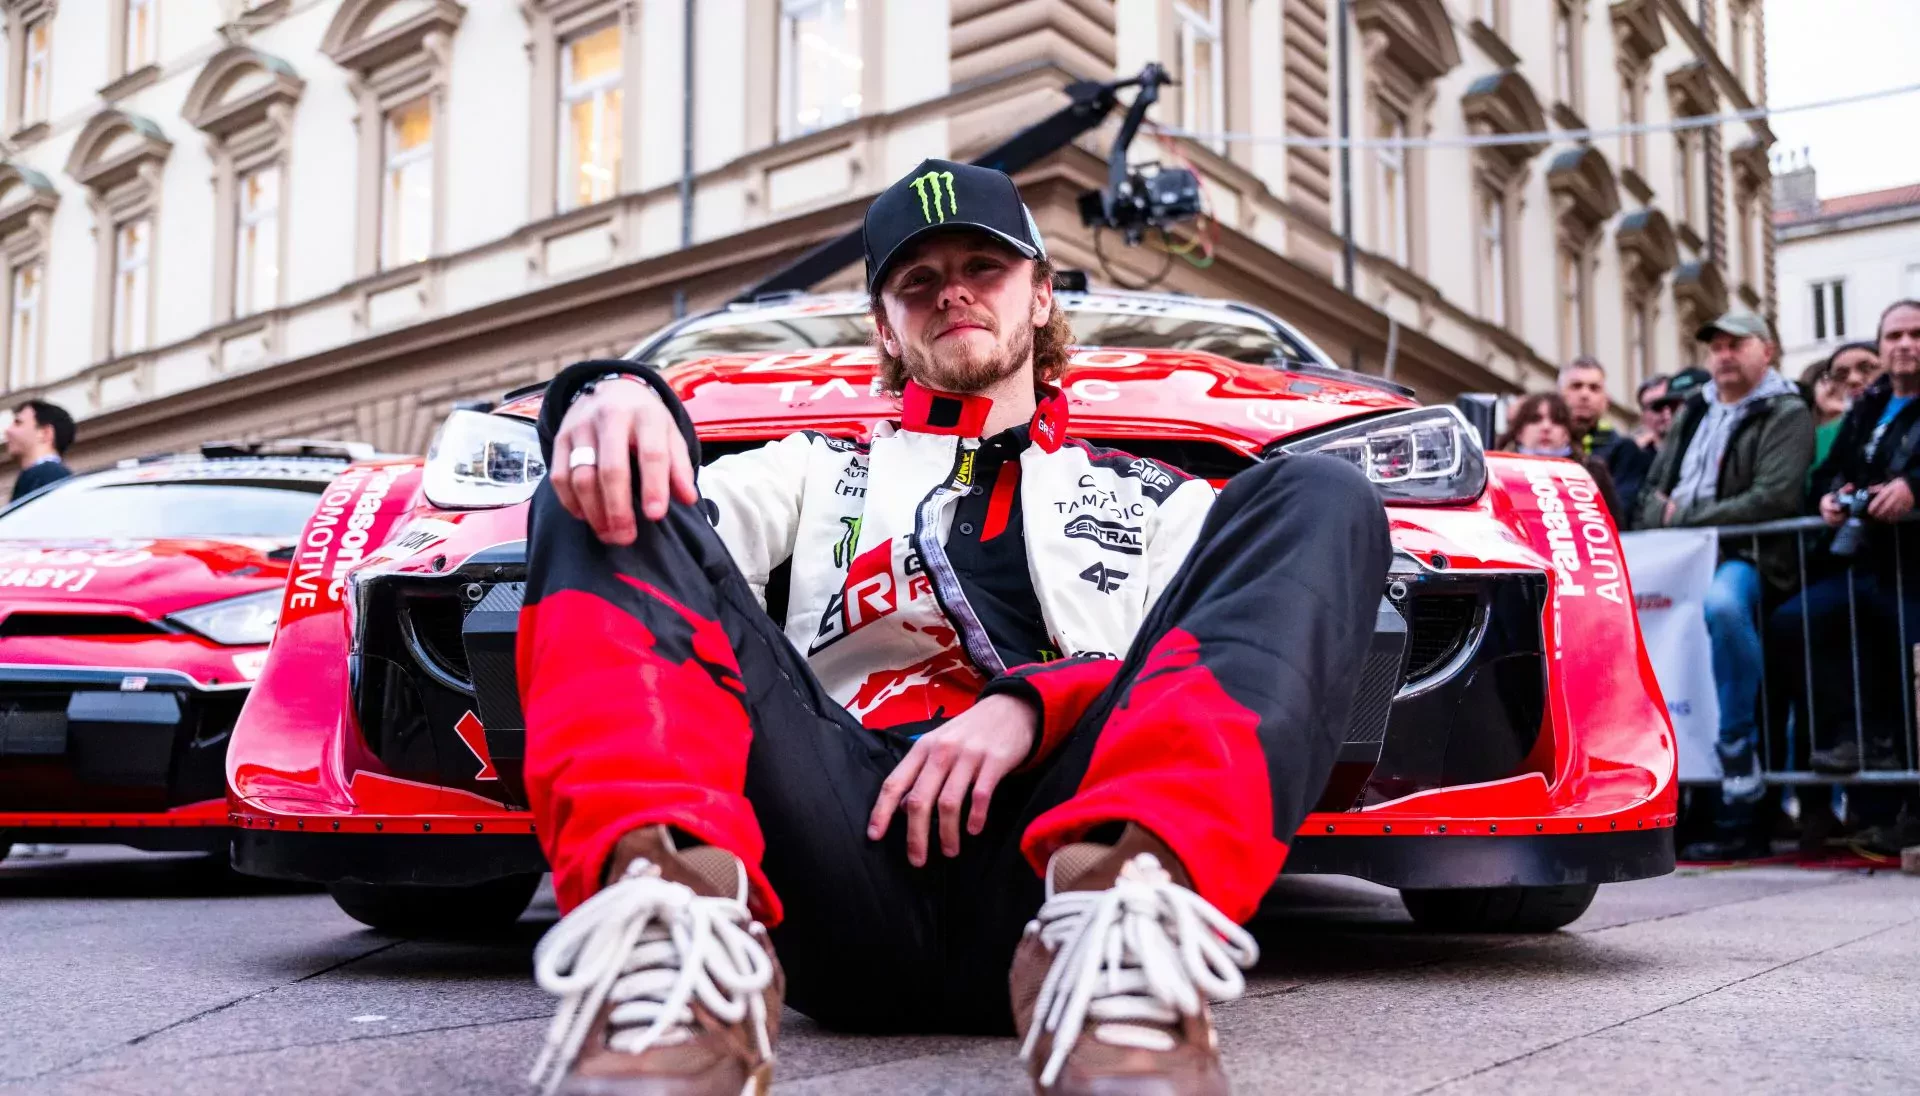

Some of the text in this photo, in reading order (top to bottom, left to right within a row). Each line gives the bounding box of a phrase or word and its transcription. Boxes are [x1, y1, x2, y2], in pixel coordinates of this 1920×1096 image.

[1064, 521, 1143, 546] CENTRAL
[1079, 561, 1129, 595] 4F
[808, 568, 897, 657] GR
